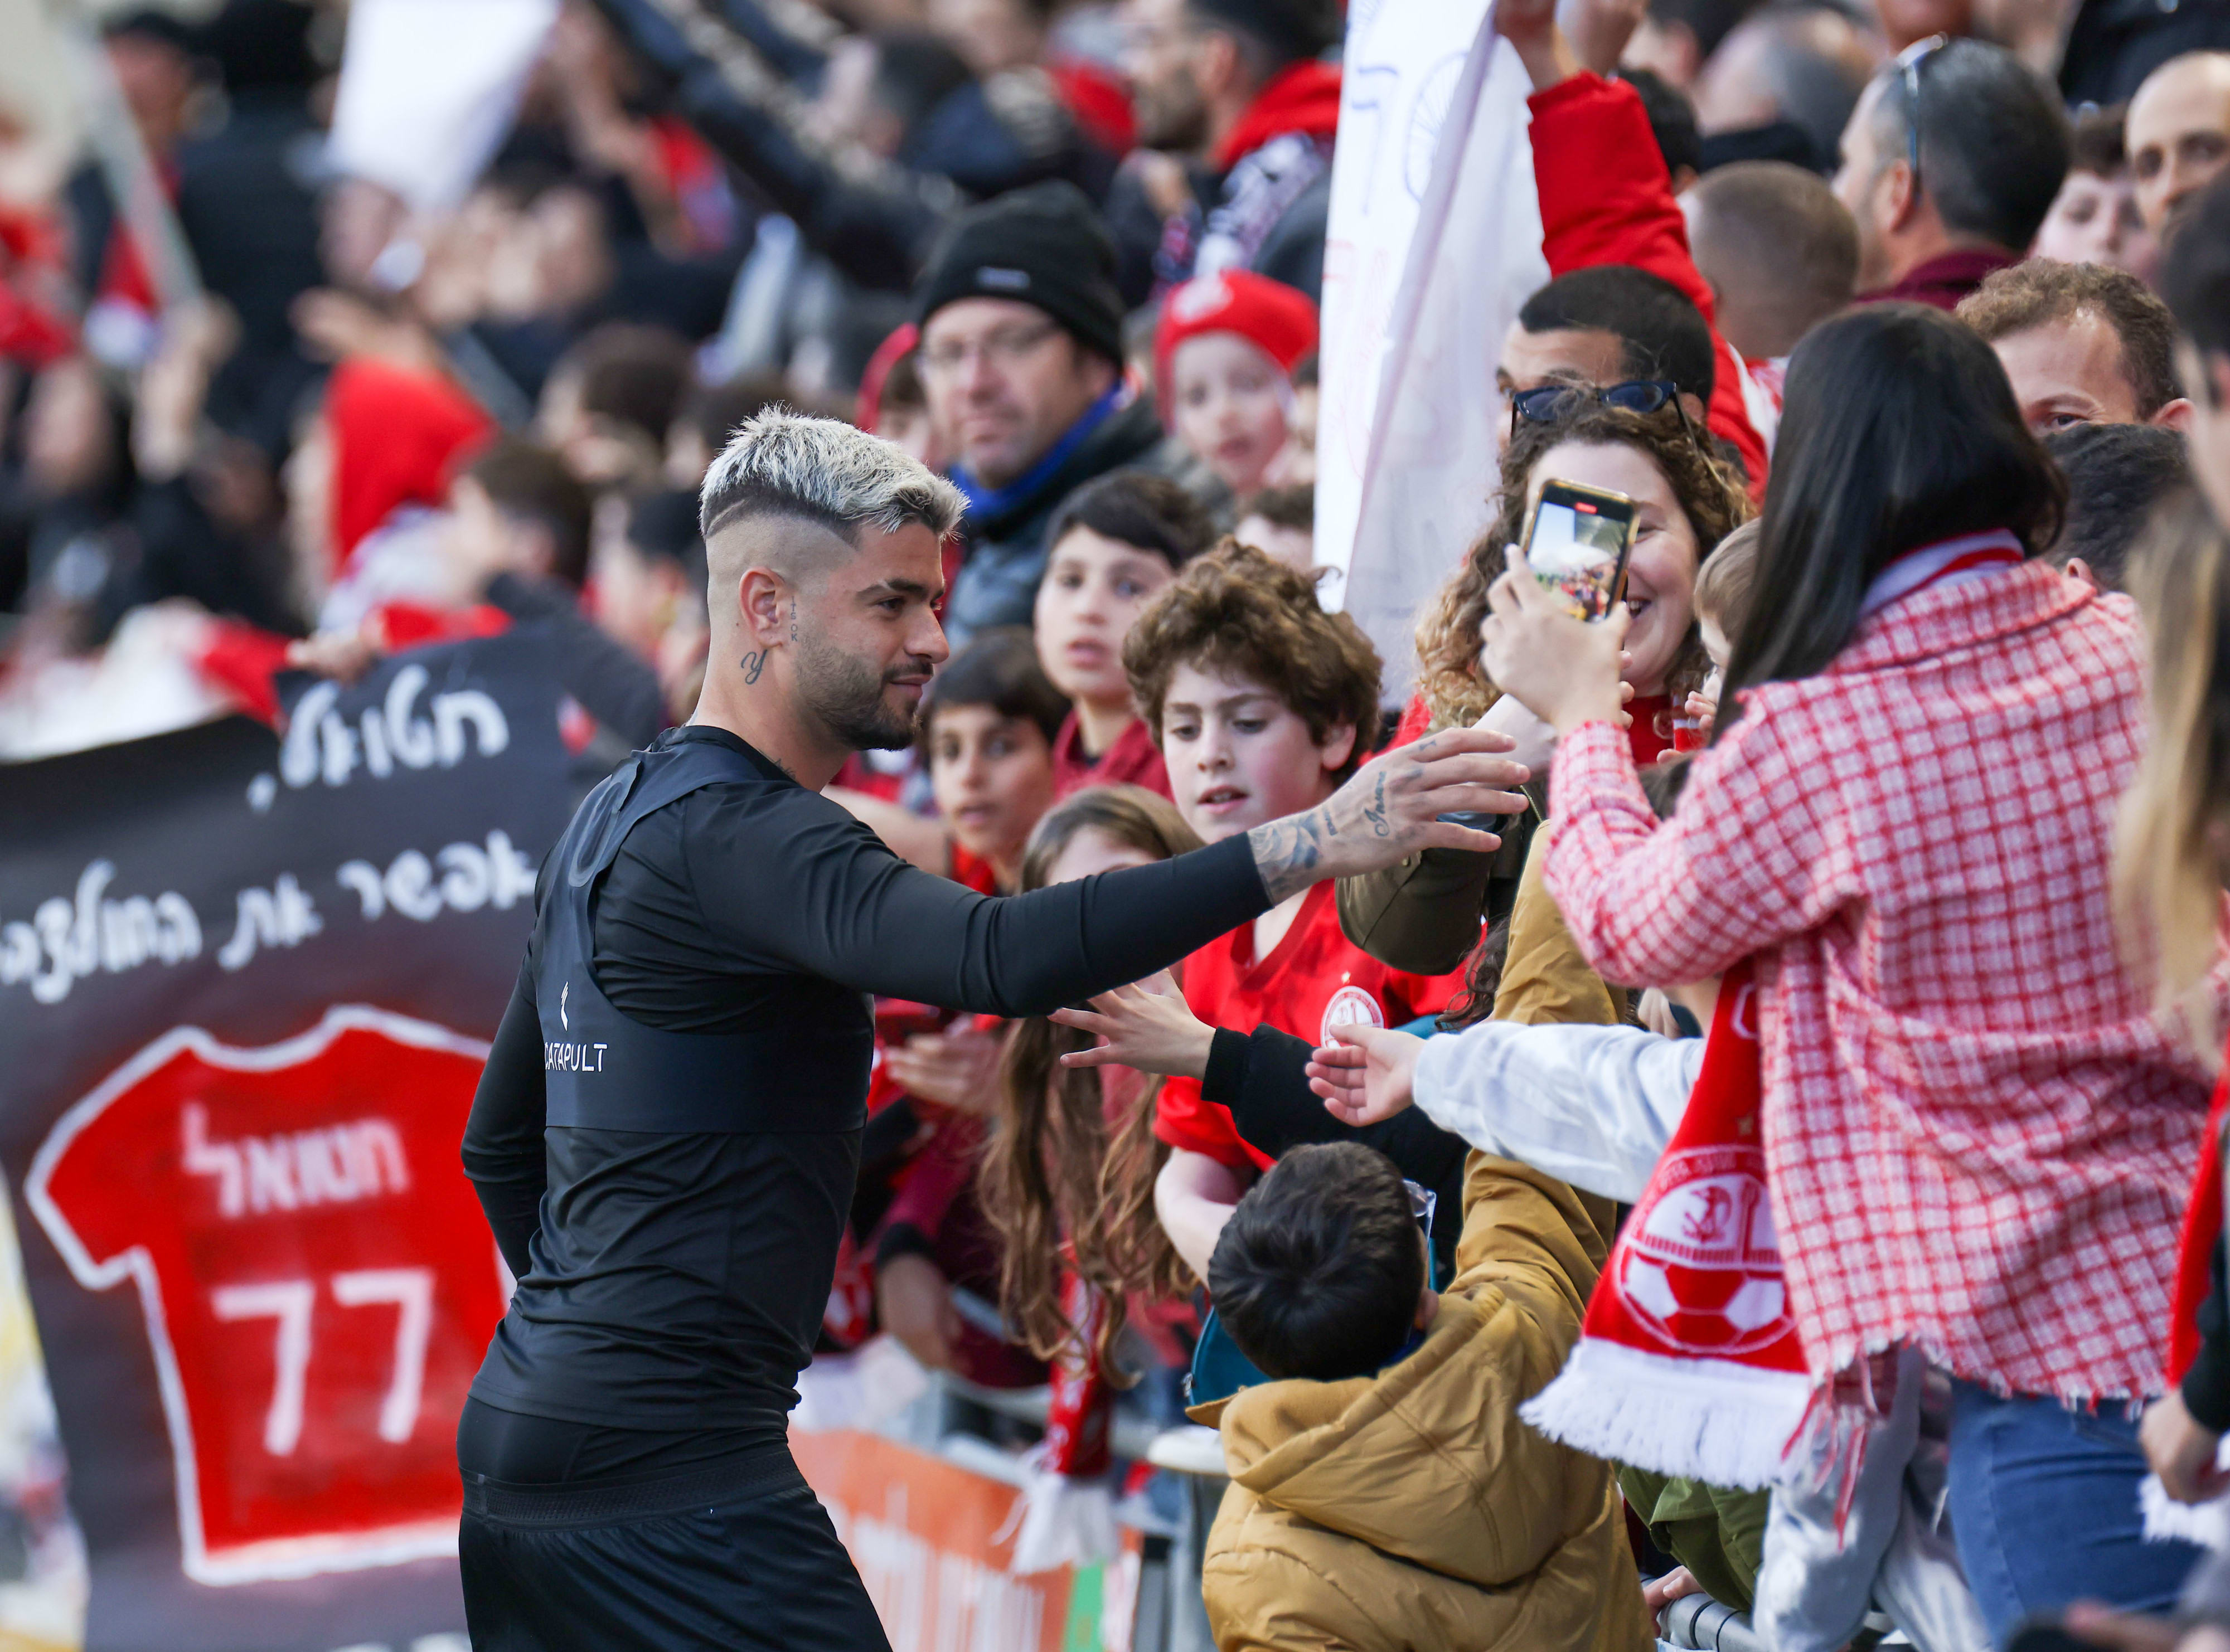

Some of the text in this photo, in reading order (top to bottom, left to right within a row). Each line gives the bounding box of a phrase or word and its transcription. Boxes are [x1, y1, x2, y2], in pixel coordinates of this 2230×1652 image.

[791, 624, 798, 642] OK
[217, 871, 325, 972] את
[336, 828, 538, 923] אפשר
[544, 1042, 608, 1072] CATAPULT
[182, 1099, 411, 1219] חטואל
[212, 1266, 436, 1458] 77
